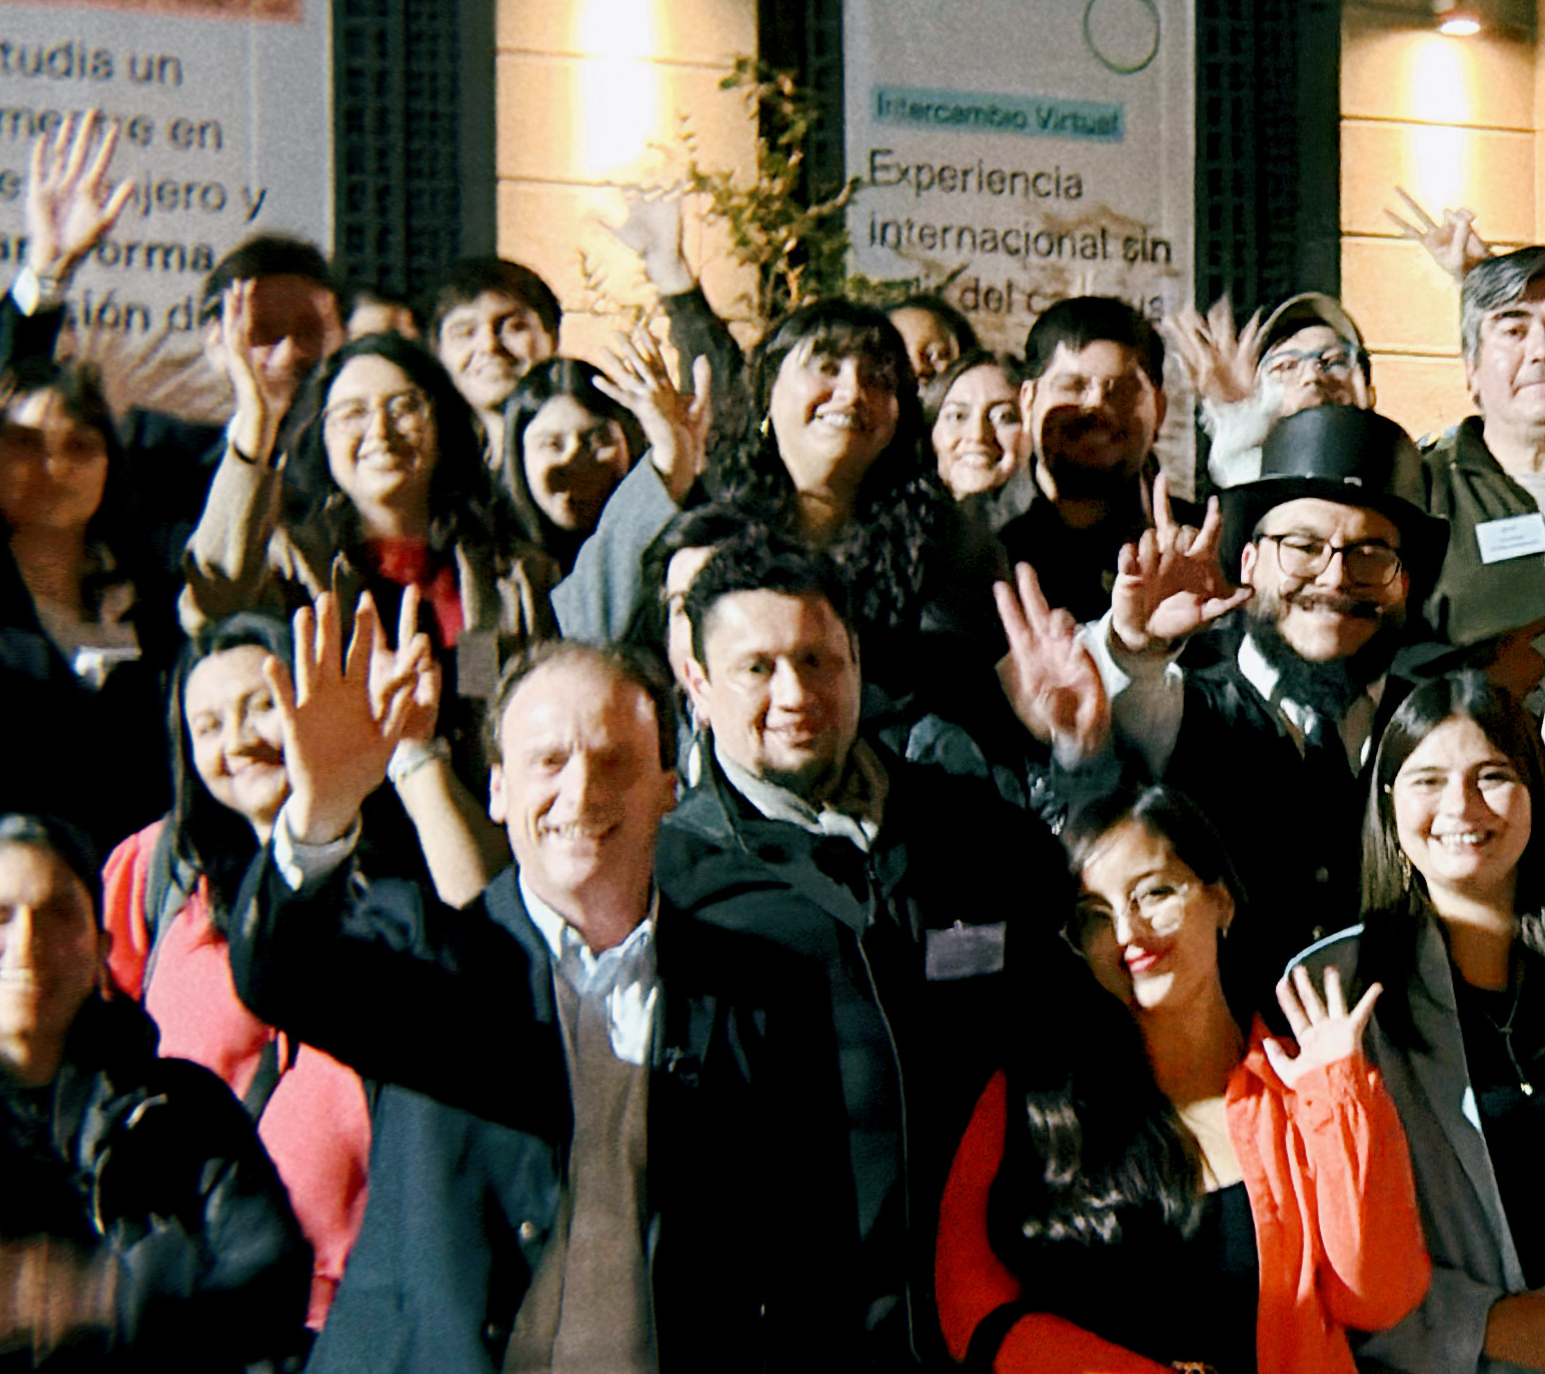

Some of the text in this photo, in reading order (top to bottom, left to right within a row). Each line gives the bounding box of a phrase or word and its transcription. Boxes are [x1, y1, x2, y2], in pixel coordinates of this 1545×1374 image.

[127, 50, 184, 86] un
[168, 115, 223, 150] en
[876, 90, 1120, 137] Intercambio Virtual
[868, 148, 1084, 199] Experiencia
[241, 183, 267, 222] y
[1122, 224, 1172, 264] sin
[958, 277, 1013, 314] del
